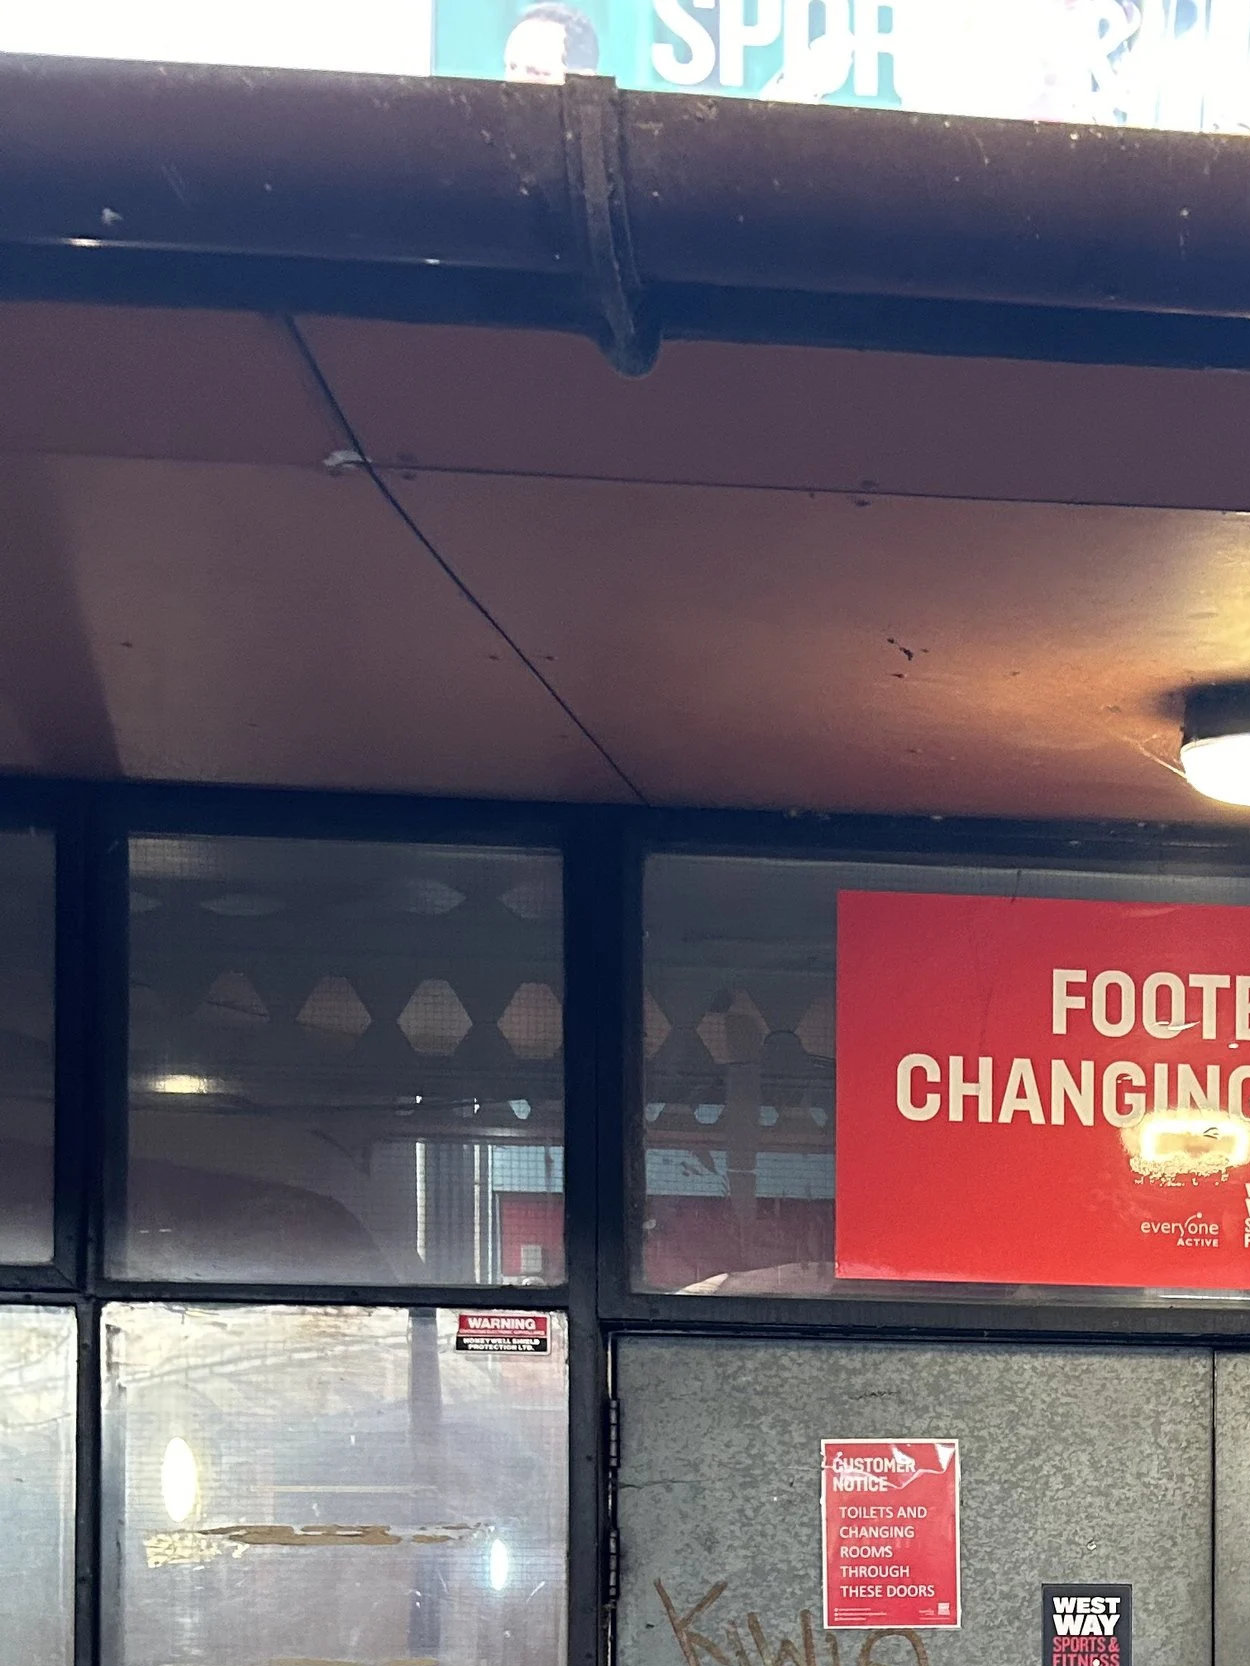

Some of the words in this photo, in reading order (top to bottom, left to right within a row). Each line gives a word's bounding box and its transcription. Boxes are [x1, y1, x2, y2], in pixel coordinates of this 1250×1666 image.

[1140, 1211, 1220, 1237] everyone
[1176, 1238, 1219, 1248] ACTIVE
[467, 1317, 537, 1330] WARNING
[832, 1457, 916, 1473] CUSTOMER
[832, 1476, 888, 1492] NOTICE
[839, 1506, 893, 1519] TOILETS
[896, 1506, 928, 1519] AND
[839, 1526, 915, 1539] CHANGING
[840, 1545, 893, 1558] ROOMS
[840, 1565, 910, 1578] THROUGH
[840, 1585, 884, 1598] THESE
[886, 1585, 936, 1598] DOORS
[1052, 1596, 1121, 1614] WEST
[1052, 1614, 1121, 1636] WAY
[1052, 1636, 1106, 1653] SPORTS
[1108, 1636, 1120, 1653] &
